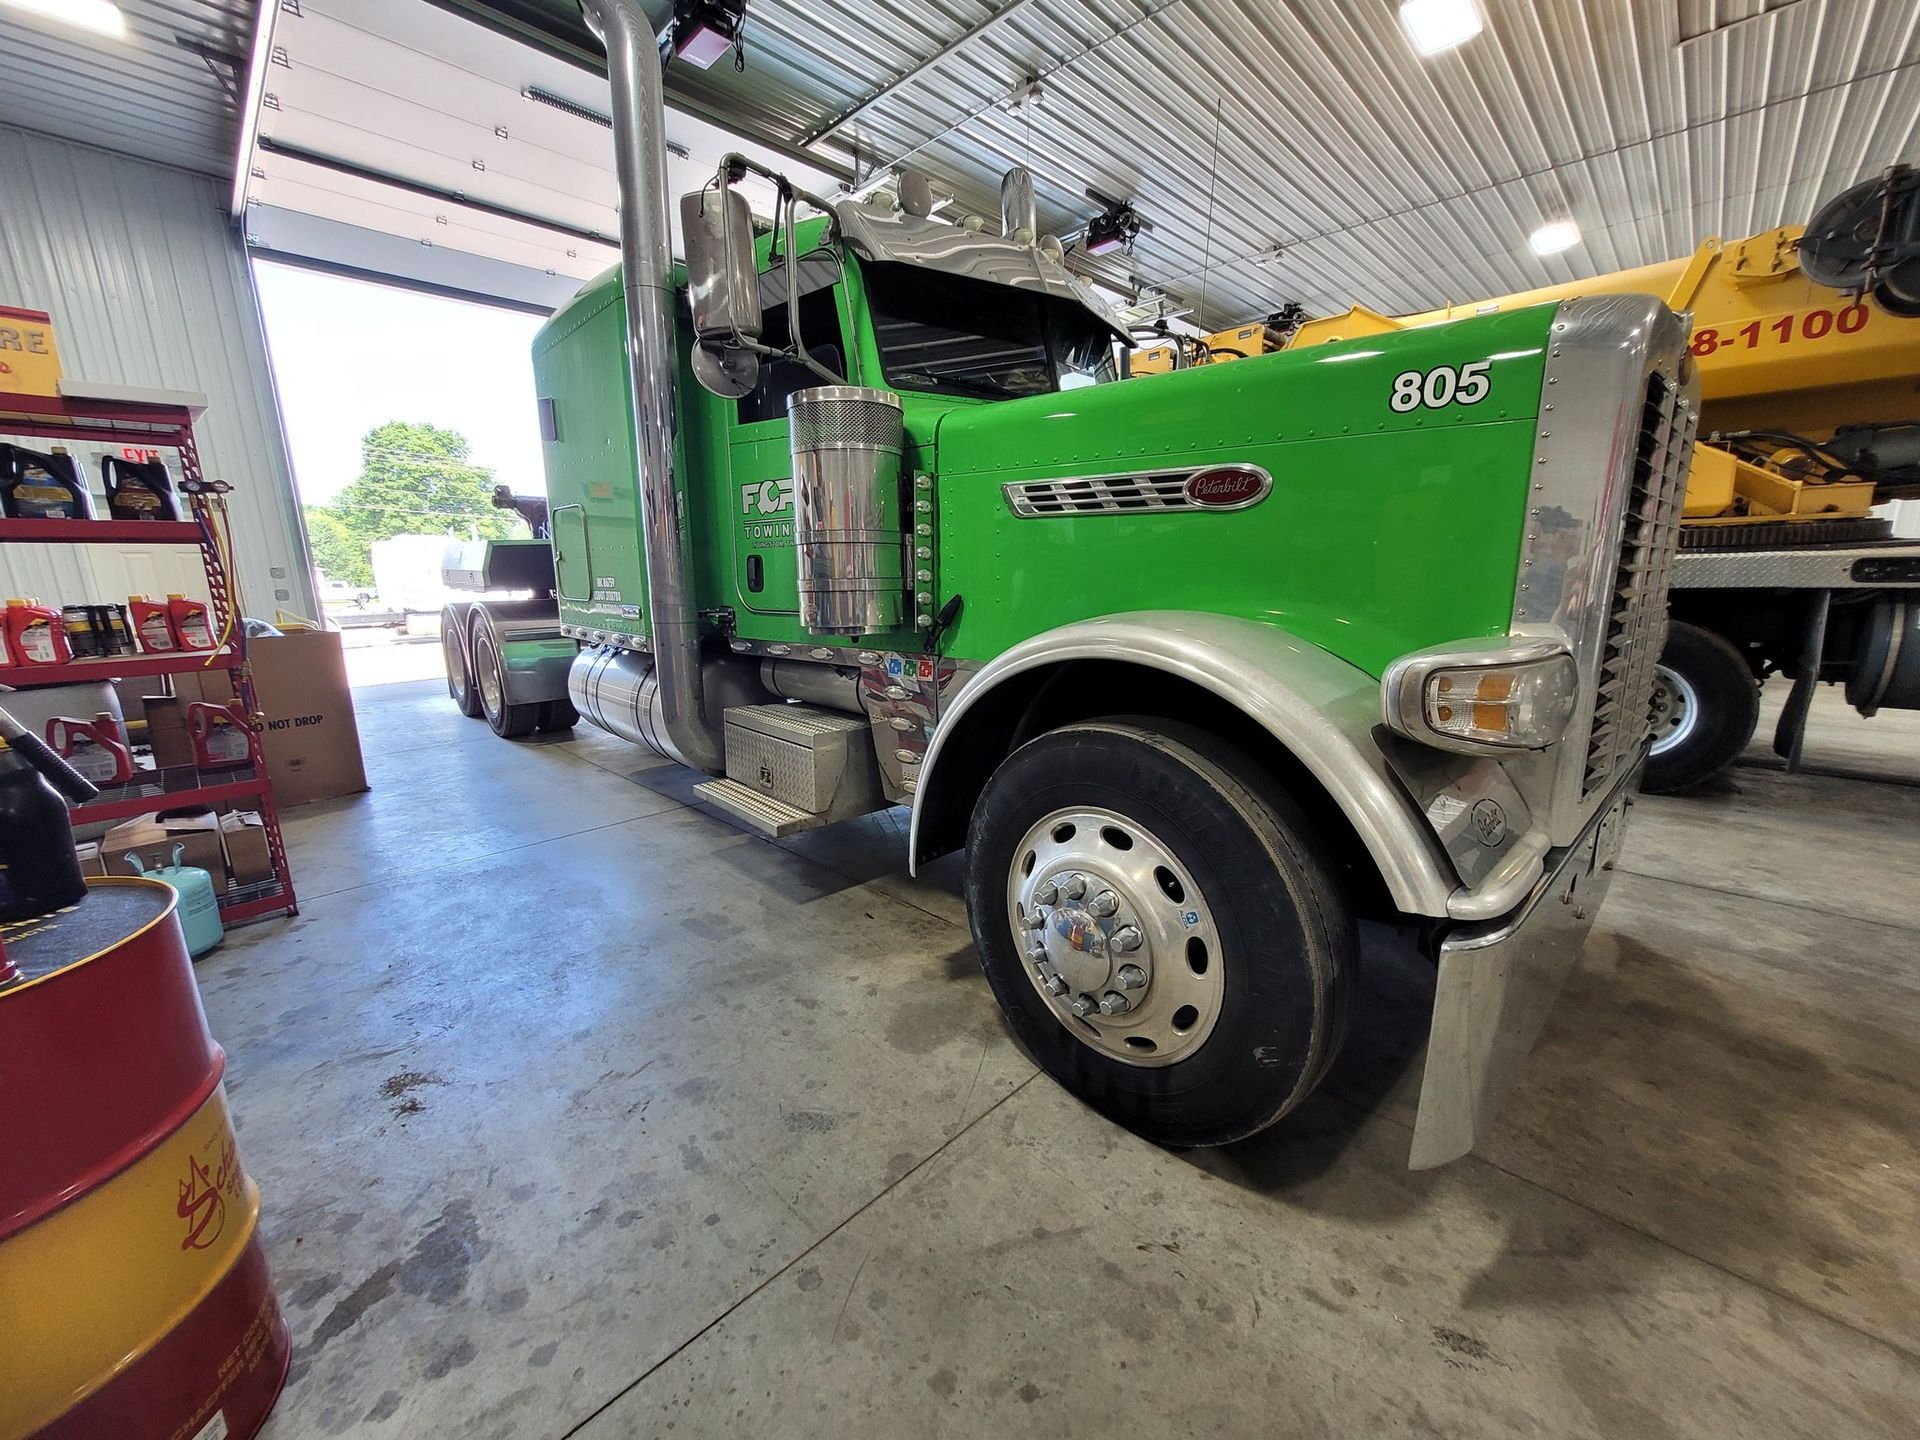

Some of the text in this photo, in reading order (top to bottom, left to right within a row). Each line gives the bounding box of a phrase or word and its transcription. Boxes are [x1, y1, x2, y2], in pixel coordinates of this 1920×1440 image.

[1691, 303, 1870, 357] 8-1100
[1389, 360, 1492, 413] 805
[1194, 476, 1256, 497] Peterbilt
[744, 523, 797, 539] TOWIN
[268, 718, 290, 731] NOT
[294, 714, 324, 727] DROP
